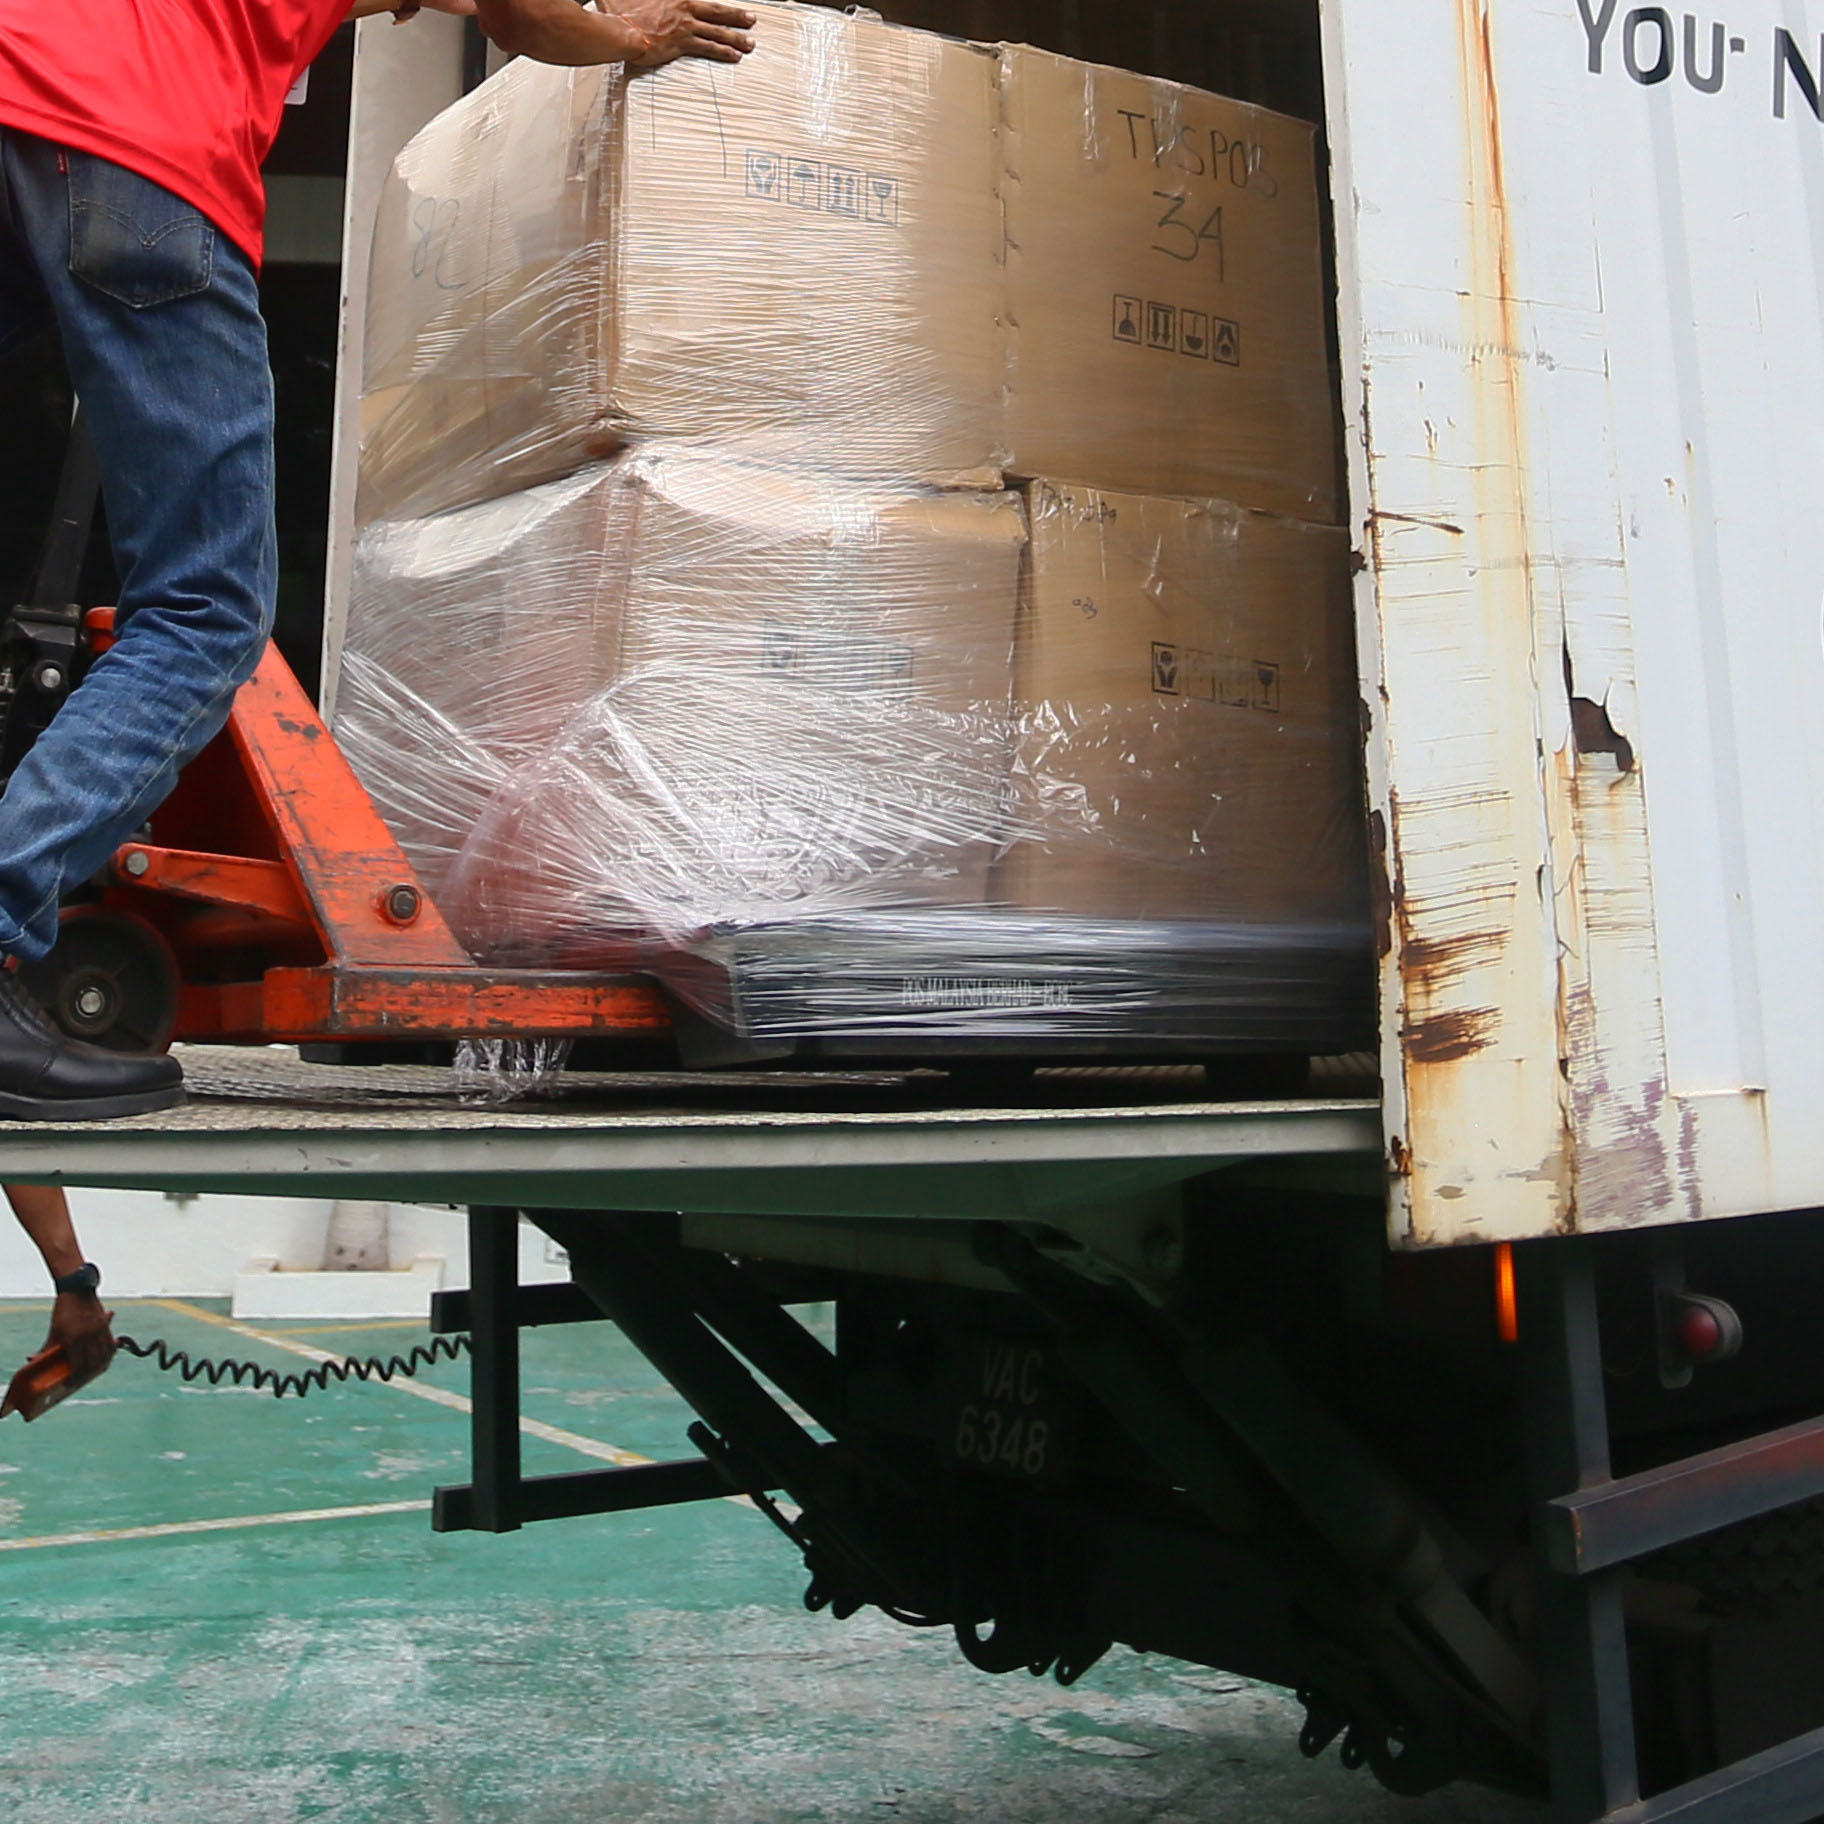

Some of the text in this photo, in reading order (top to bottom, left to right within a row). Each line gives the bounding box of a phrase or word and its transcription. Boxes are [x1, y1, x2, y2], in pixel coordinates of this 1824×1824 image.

[1151, 189, 1225, 284] 34
[982, 1343, 1044, 1406] VAC
[955, 1402, 1049, 1475] 6348
